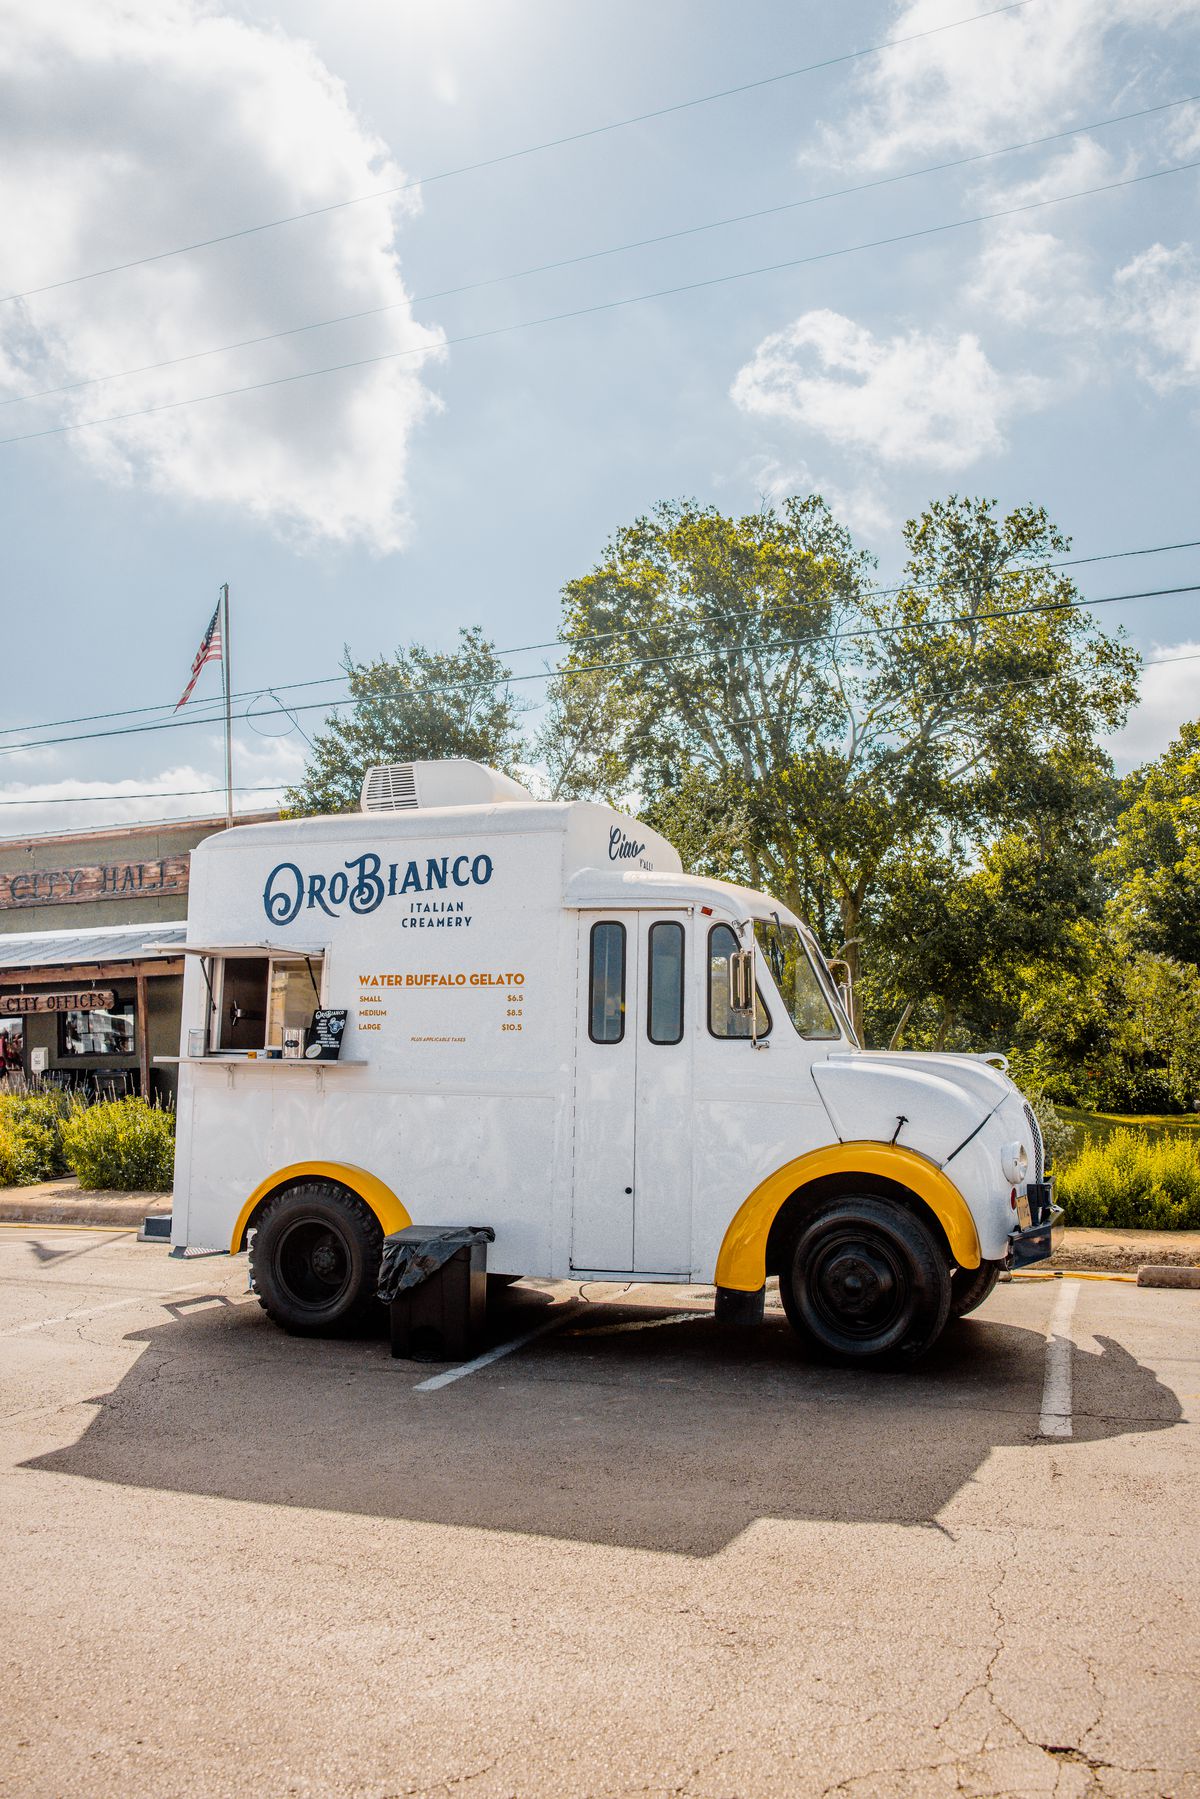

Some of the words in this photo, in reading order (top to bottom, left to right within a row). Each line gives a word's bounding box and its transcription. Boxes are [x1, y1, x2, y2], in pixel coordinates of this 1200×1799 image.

[608, 825, 645, 860] Ciao
[9, 870, 83, 902] CITY
[100, 861, 178, 894] HALL
[410, 901, 464, 913] ITALIAN
[401, 916, 473, 928] CREAMERY
[358, 975, 403, 987] WATER
[406, 973, 466, 986] BUFFALO
[469, 973, 525, 986] GELATO
[6, 997, 39, 1012] CITY
[47, 993, 105, 1009] OFFICES
[359, 995, 382, 1003] SMALL
[359, 1009, 387, 1017] MEDIUM
[506, 1009, 523, 1017] $8.5
[358, 1023, 381, 1031] LARGE
[501, 1023, 523, 1031] $10.5
